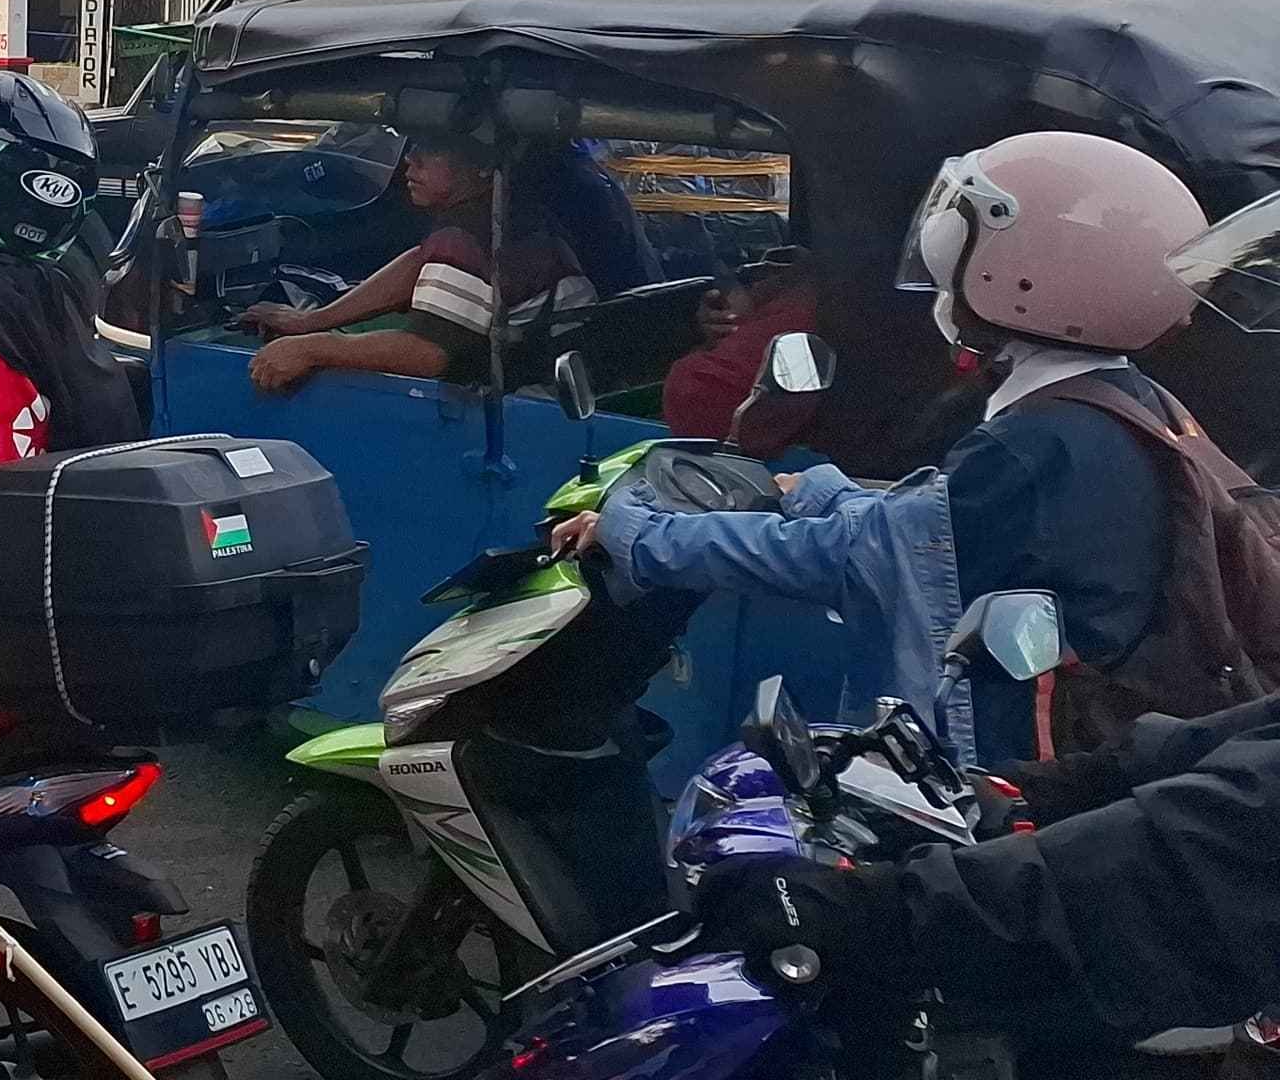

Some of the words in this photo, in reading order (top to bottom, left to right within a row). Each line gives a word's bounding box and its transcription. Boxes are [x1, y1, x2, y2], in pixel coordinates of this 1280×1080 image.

[212, 544, 253, 558] PALESTINA
[389, 761, 447, 775] HONDA
[114, 971, 137, 1010] E
[142, 950, 197, 1001] 5295
[198, 938, 241, 982] YBJ
